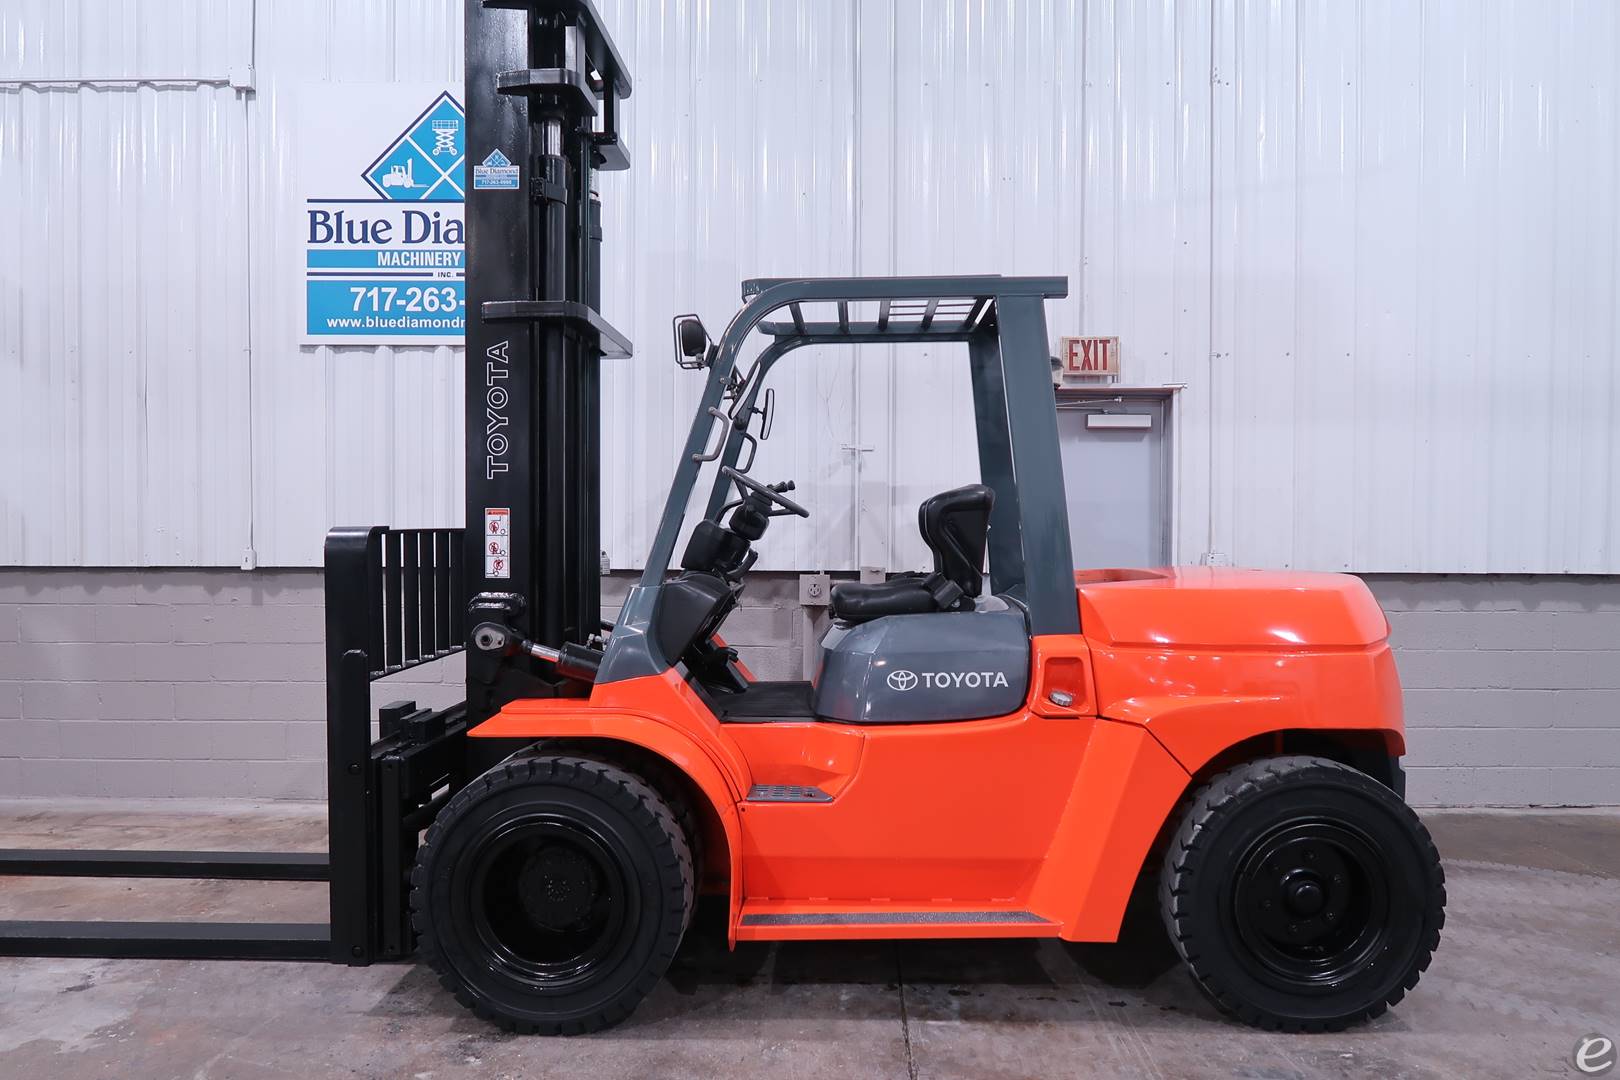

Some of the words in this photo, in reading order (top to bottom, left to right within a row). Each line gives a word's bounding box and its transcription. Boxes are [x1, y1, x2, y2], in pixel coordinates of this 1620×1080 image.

[307, 210, 392, 244] Blue
[402, 210, 465, 244] Dia
[377, 251, 461, 266] MACHINERY
[1069, 339, 1110, 371] EXIT
[486, 340, 508, 480] TOYOTA
[922, 671, 1008, 688] TOYOTA
